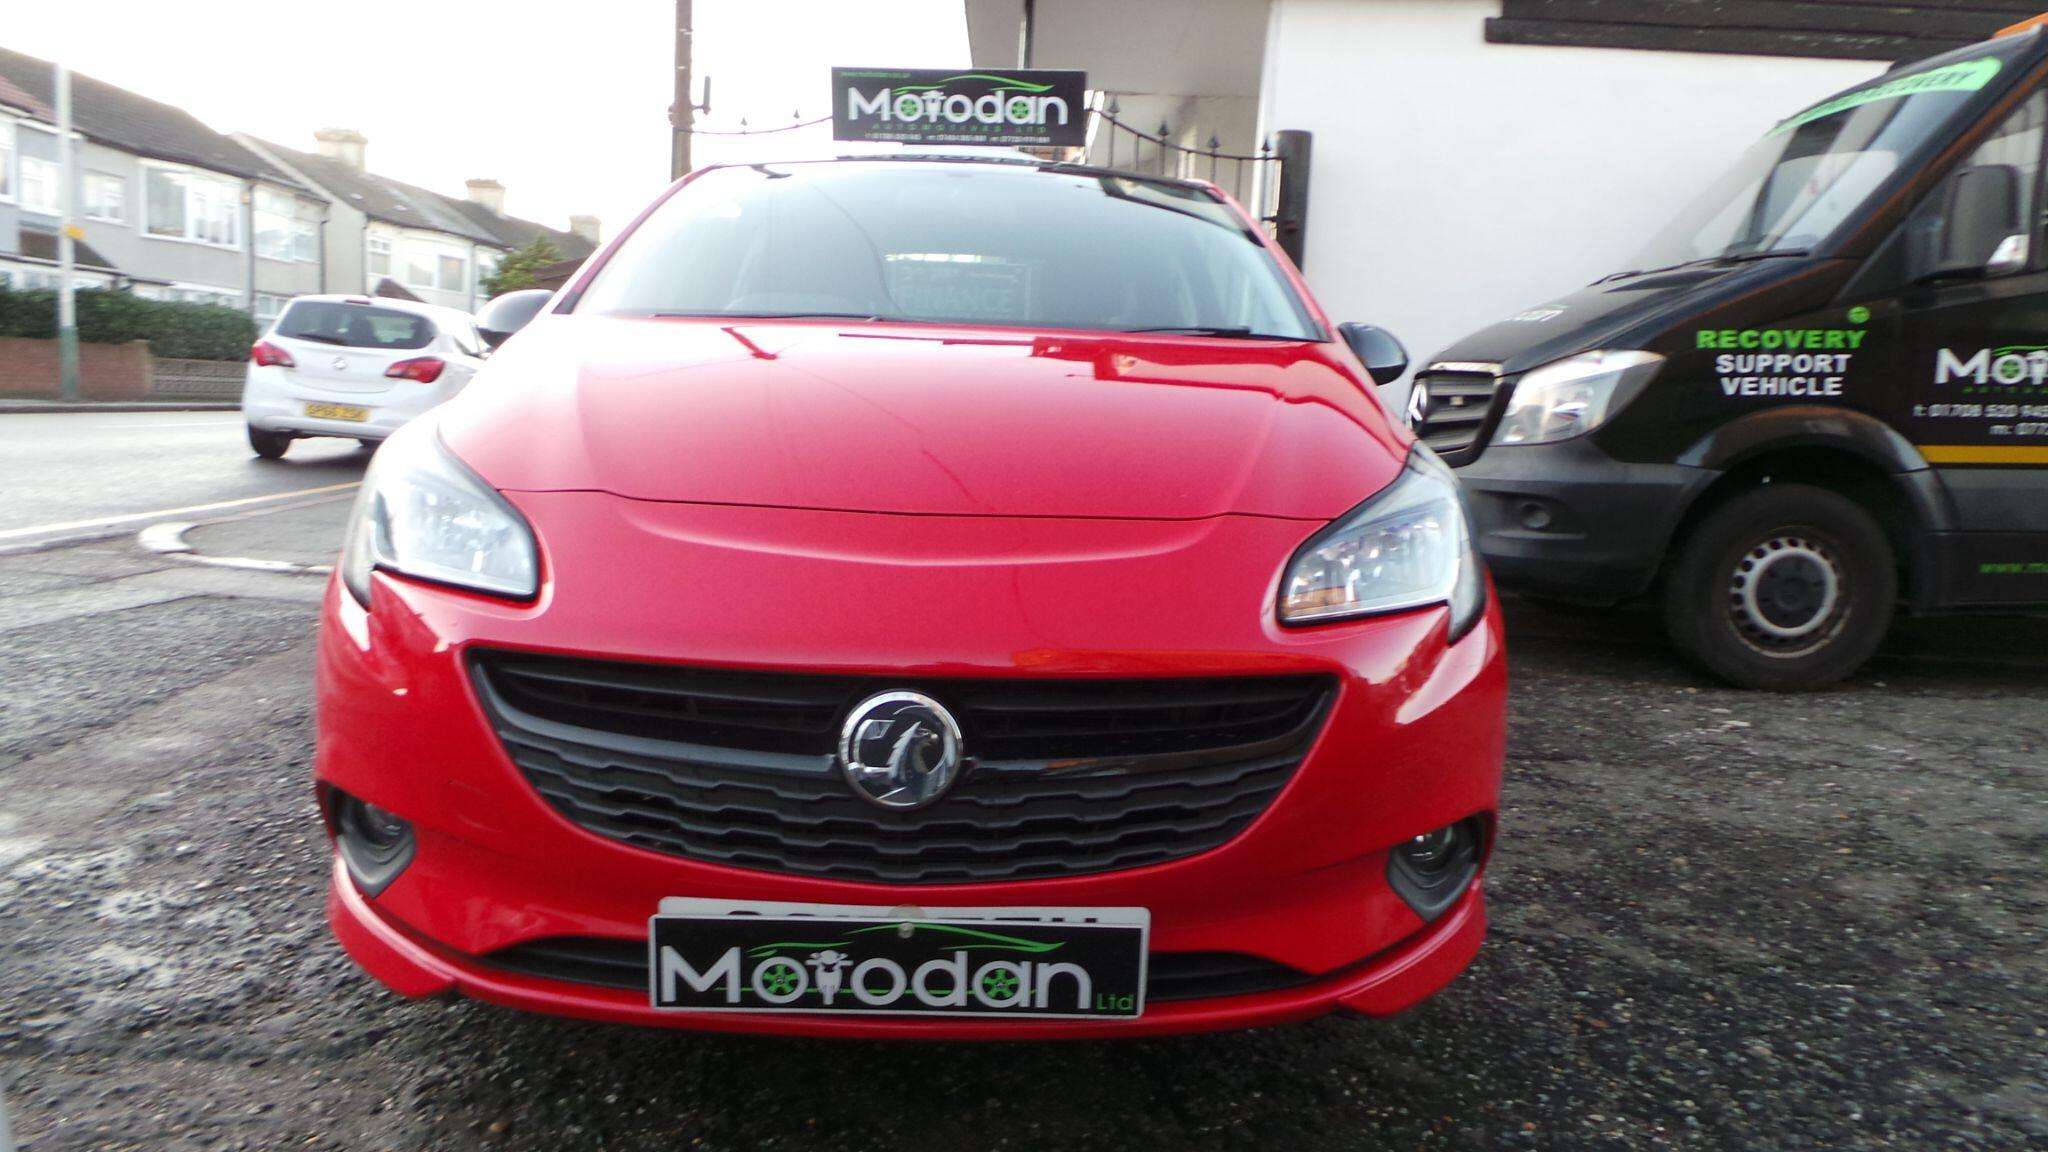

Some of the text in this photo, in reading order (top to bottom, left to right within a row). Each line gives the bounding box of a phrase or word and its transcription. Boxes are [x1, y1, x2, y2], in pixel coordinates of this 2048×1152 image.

[1696, 329, 1867, 349] RECOVERY
[1715, 353, 1853, 374] SUPPORT
[1720, 376, 1844, 396] VEHICLE
